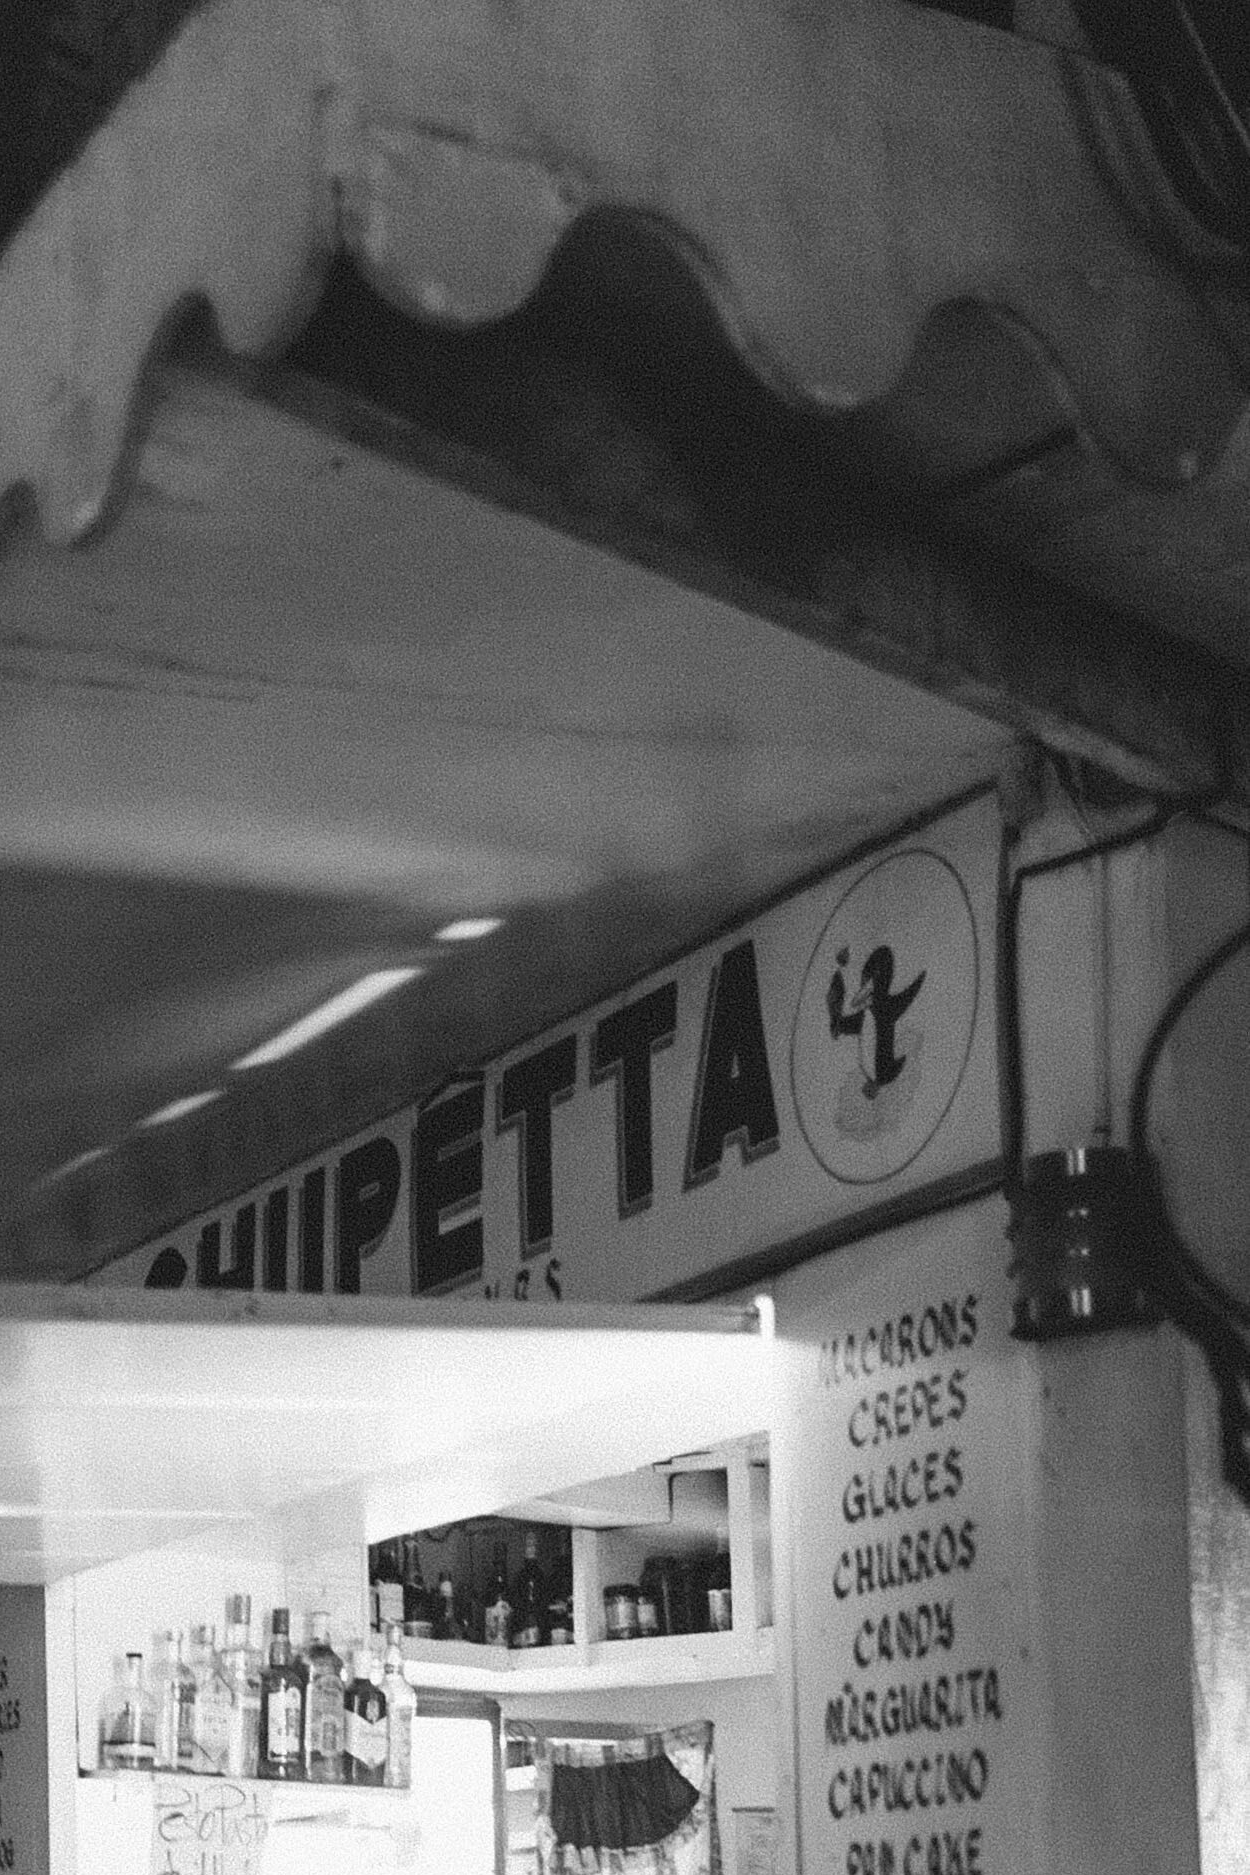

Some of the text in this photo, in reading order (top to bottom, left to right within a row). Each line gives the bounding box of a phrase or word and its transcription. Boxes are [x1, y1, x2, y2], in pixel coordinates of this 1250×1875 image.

[848, 1368, 969, 1448] CREPES
[842, 1445, 964, 1525] GLACES
[832, 1518, 977, 1600] CHURROS
[854, 1599, 956, 1669] CANDY
[828, 1747, 989, 1820] CAPUCCINO
